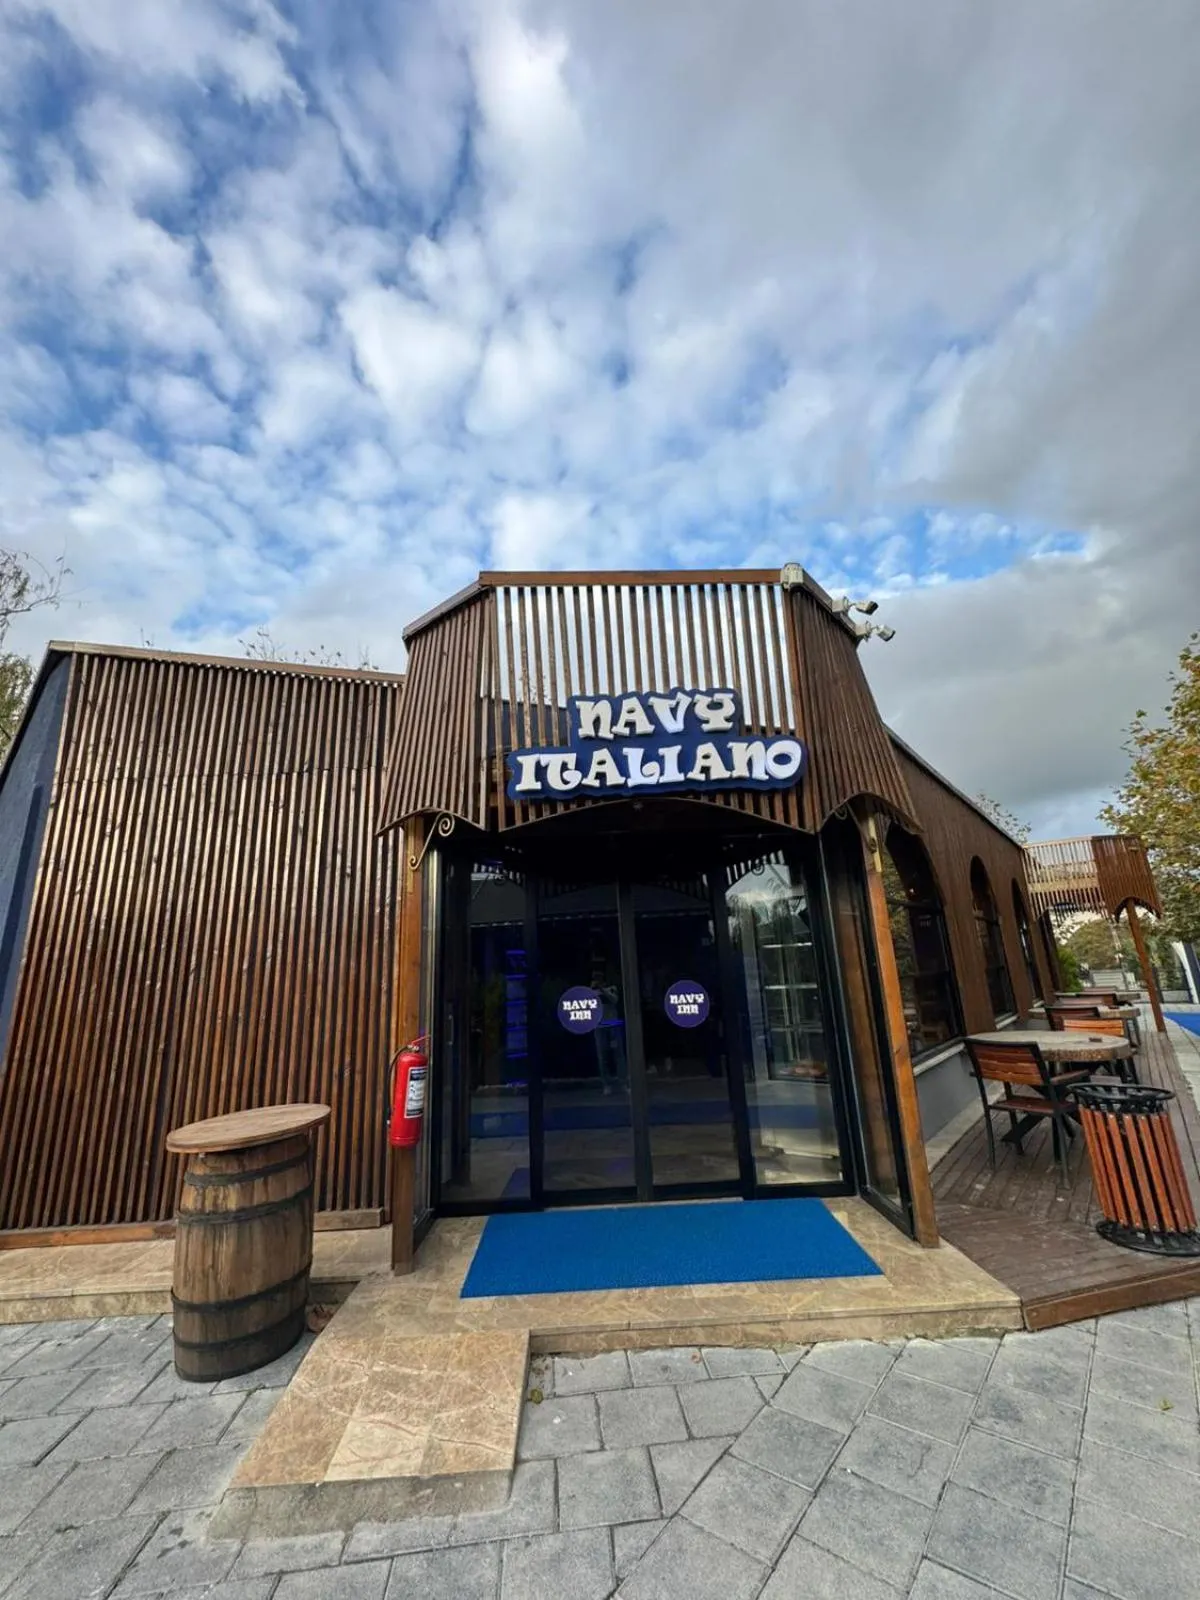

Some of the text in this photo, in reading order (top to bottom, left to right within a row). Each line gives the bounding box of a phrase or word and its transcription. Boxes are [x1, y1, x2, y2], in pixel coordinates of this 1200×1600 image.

[576, 692, 736, 740] NAVY
[515, 739, 802, 792] ITALIANO
[669, 993, 705, 1004] NAVY
[562, 999, 598, 1011] NAVY
[676, 1004, 699, 1015] INN
[569, 1010, 592, 1021] INN
